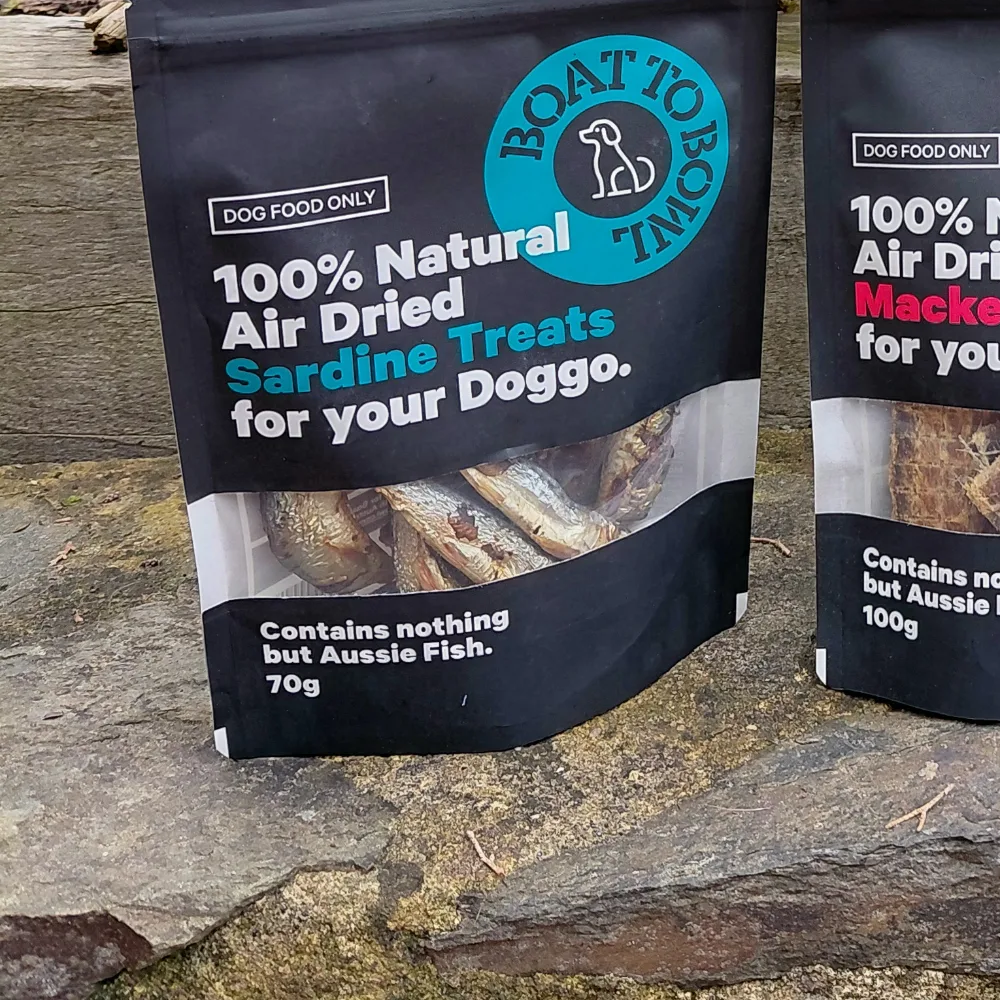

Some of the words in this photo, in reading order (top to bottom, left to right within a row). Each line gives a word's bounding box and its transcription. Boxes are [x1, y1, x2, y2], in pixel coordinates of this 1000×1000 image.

[500, 50, 637, 160] BOAT
[641, 55, 704, 122] TO
[863, 143, 898, 158] DOG
[900, 143, 946, 159] FOOD
[948, 143, 991, 159] ONLY
[223, 205, 267, 225] DOG
[270, 199, 324, 219] FOOD
[327, 189, 378, 211] ONLY
[612, 120, 718, 264] BOWL
[850, 195, 974, 235] 100%
[213, 250, 363, 303] 100%
[376, 211, 570, 285] Natural
[853, 239, 922, 278] Air
[221, 310, 305, 350] Air
[321, 277, 465, 344] Dried
[226, 339, 438, 395] Sardine
[448, 306, 615, 364] Treats
[856, 323, 920, 364] for
[231, 400, 310, 438] for
[324, 386, 446, 445] your
[458, 353, 632, 412] Doggo.
[862, 546, 968, 587] Contains
[863, 571, 902, 600] but
[906, 584, 990, 616] Aussie
[260, 620, 390, 642] Contains
[396, 609, 510, 638] nothing
[863, 605, 919, 641] 100g
[263, 644, 312, 665] but
[320, 643, 416, 665] Aussie
[423, 637, 493, 662] Fish.
[266, 674, 321, 698] 70g
